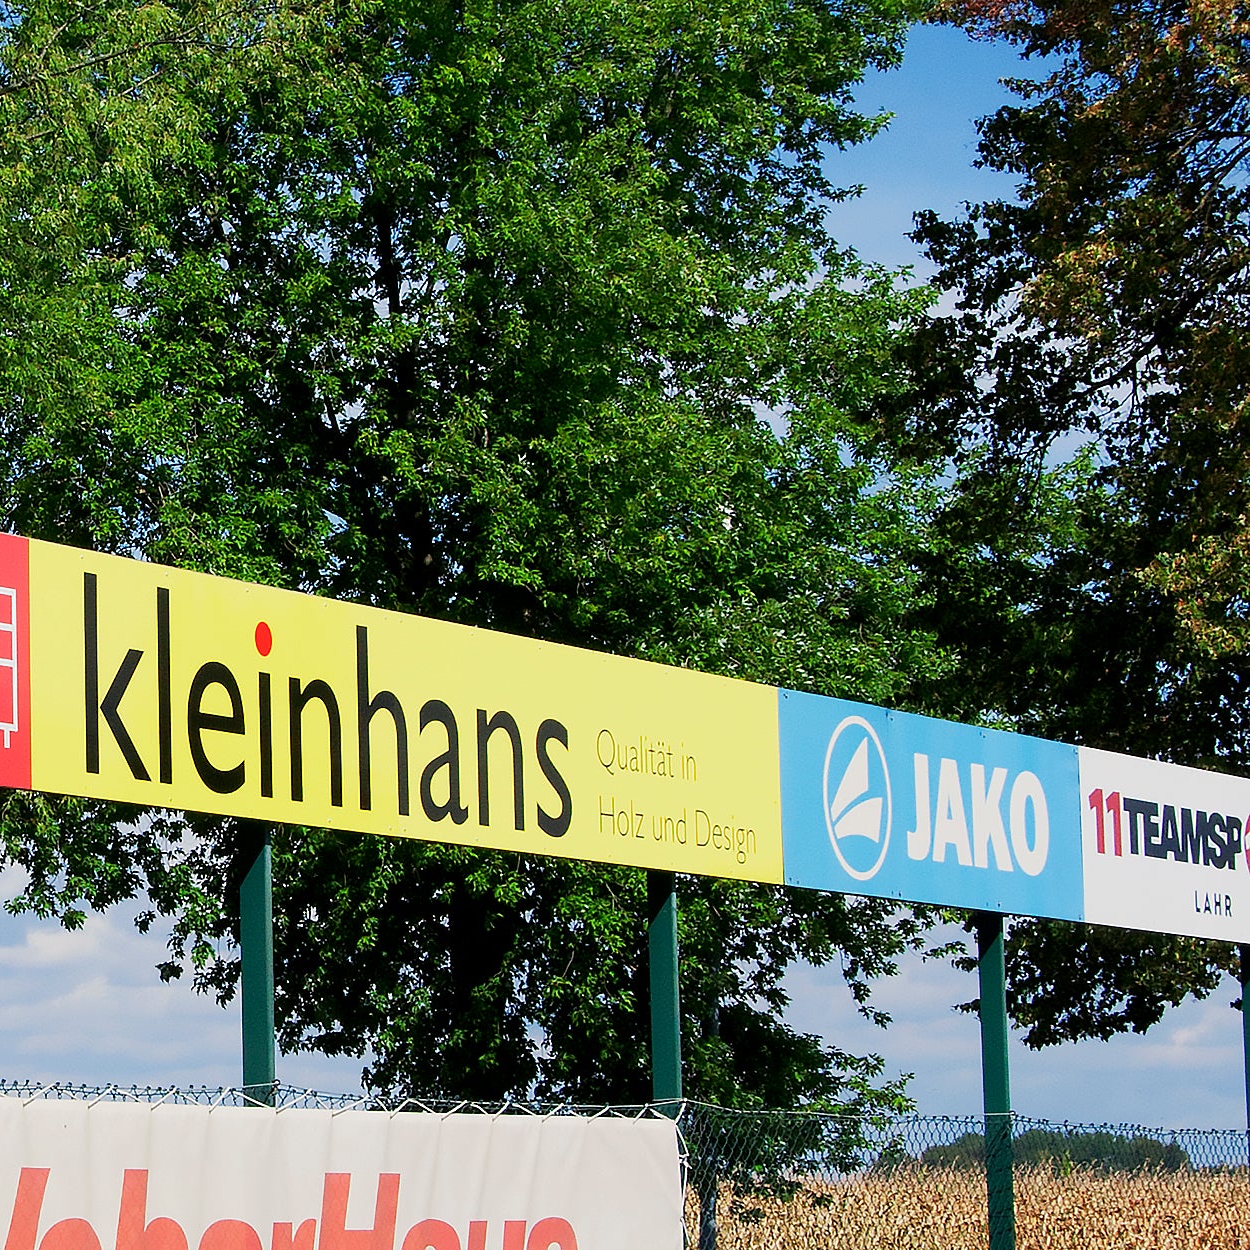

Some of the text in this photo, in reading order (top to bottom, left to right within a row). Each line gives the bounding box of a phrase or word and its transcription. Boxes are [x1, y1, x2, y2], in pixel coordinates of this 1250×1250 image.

[83, 571, 573, 838] kleinhans
[596, 729, 697, 782] Qualität in
[599, 795, 757, 865] Holz und Design
[906, 752, 1050, 877] JAKO
[1088, 788, 1250, 874] 11TEAMSP
[1194, 890, 1233, 918] LAHR
